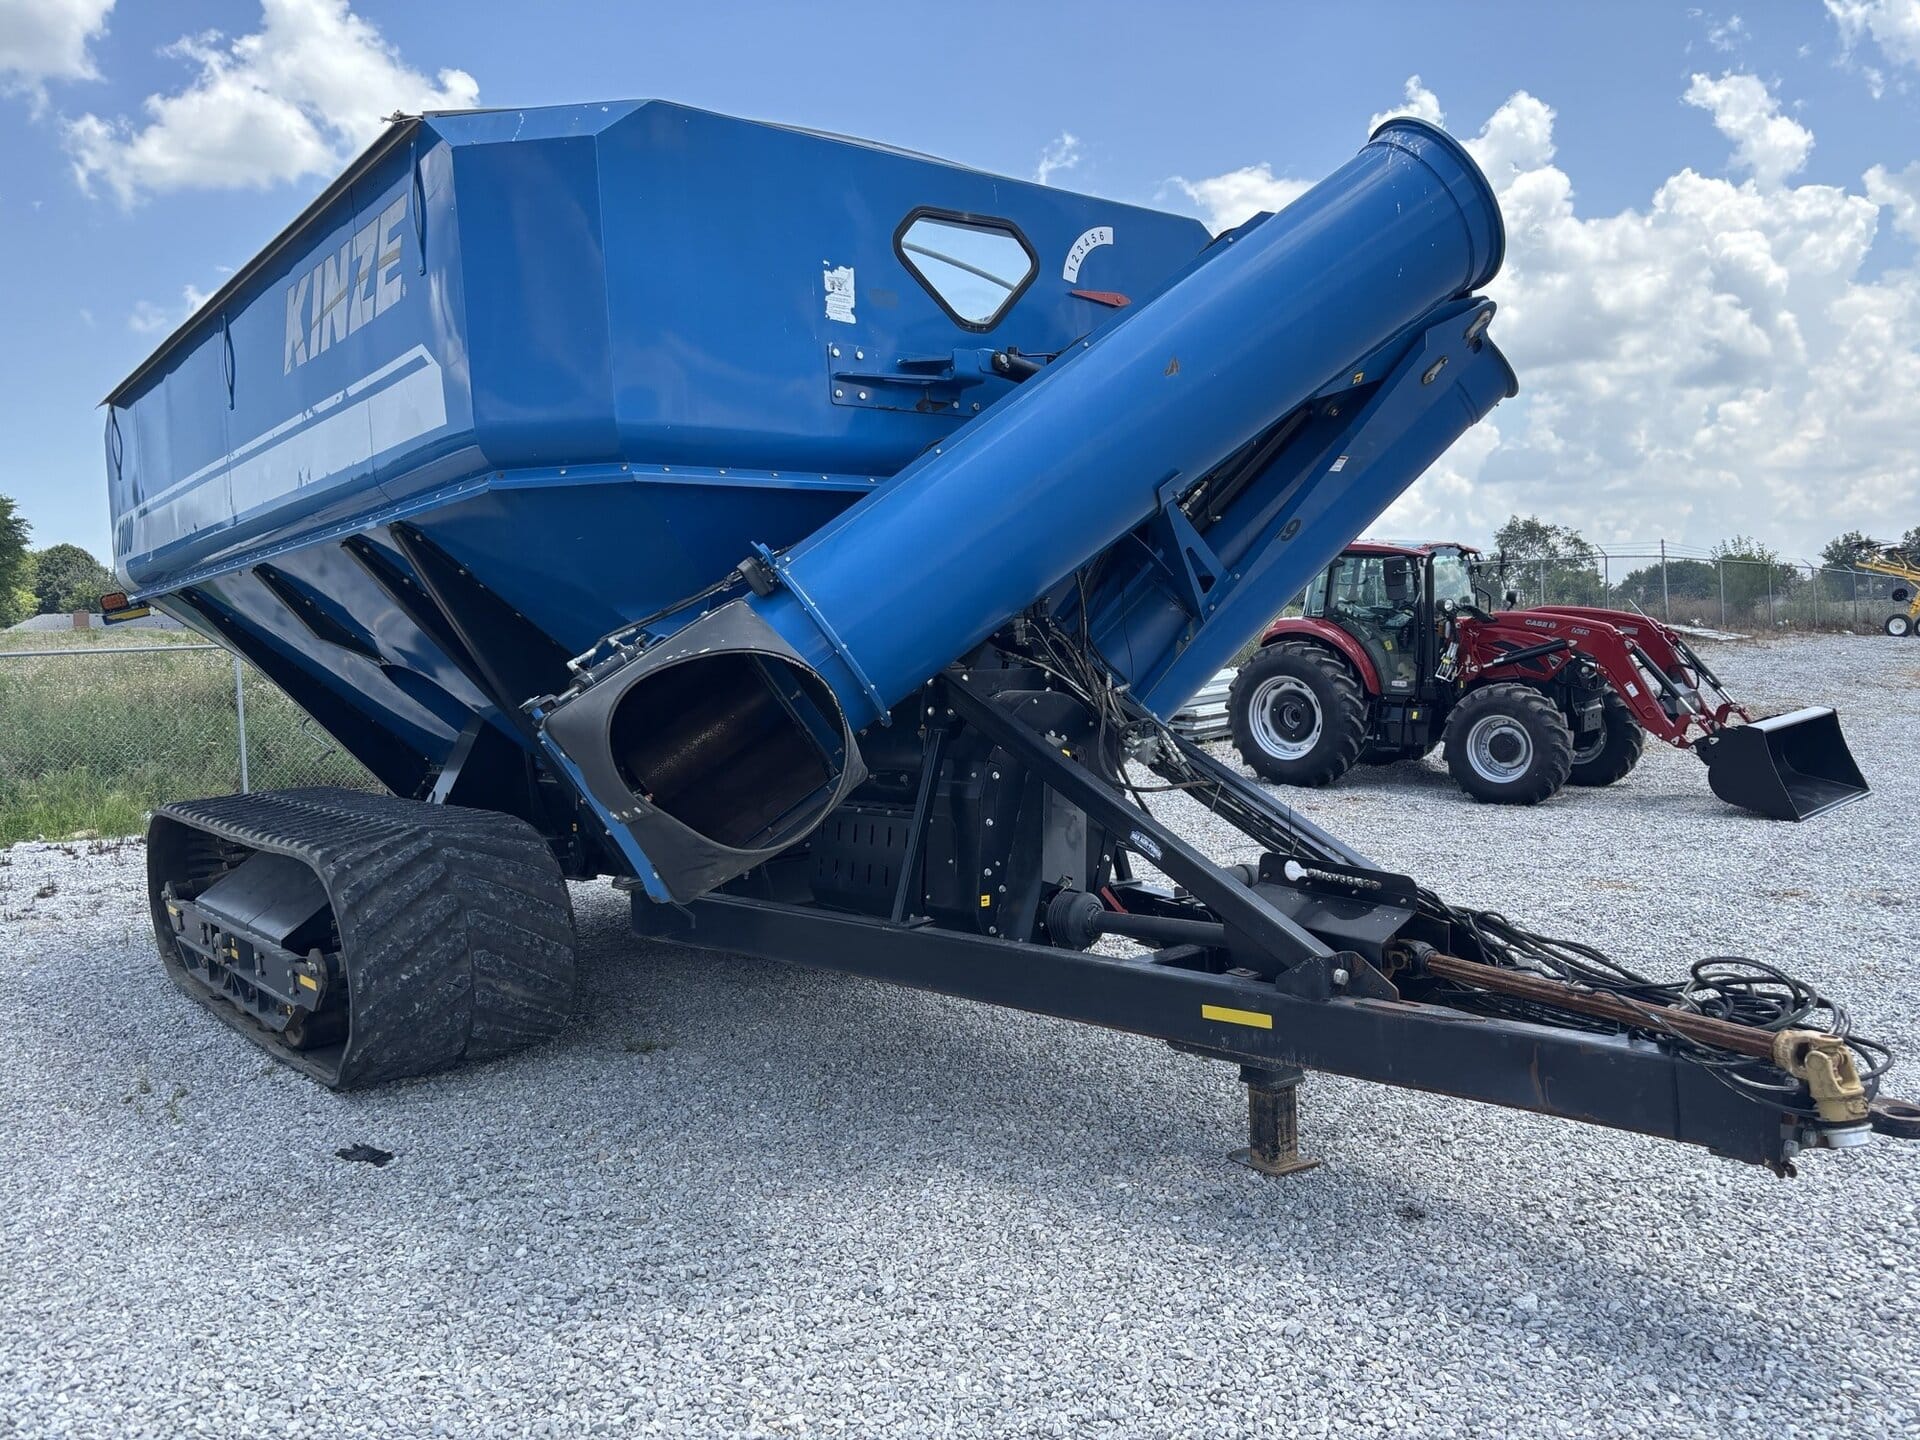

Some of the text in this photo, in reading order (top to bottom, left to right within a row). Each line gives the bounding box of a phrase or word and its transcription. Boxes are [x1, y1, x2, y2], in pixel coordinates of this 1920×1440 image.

[284, 192, 407, 376] KINZE
[1072, 254, 1080, 263] 2
[1077, 245, 1084, 254] 3
[1084, 237, 1090, 247] 4
[1091, 233, 1097, 243] 5
[1099, 231, 1104, 241] 6
